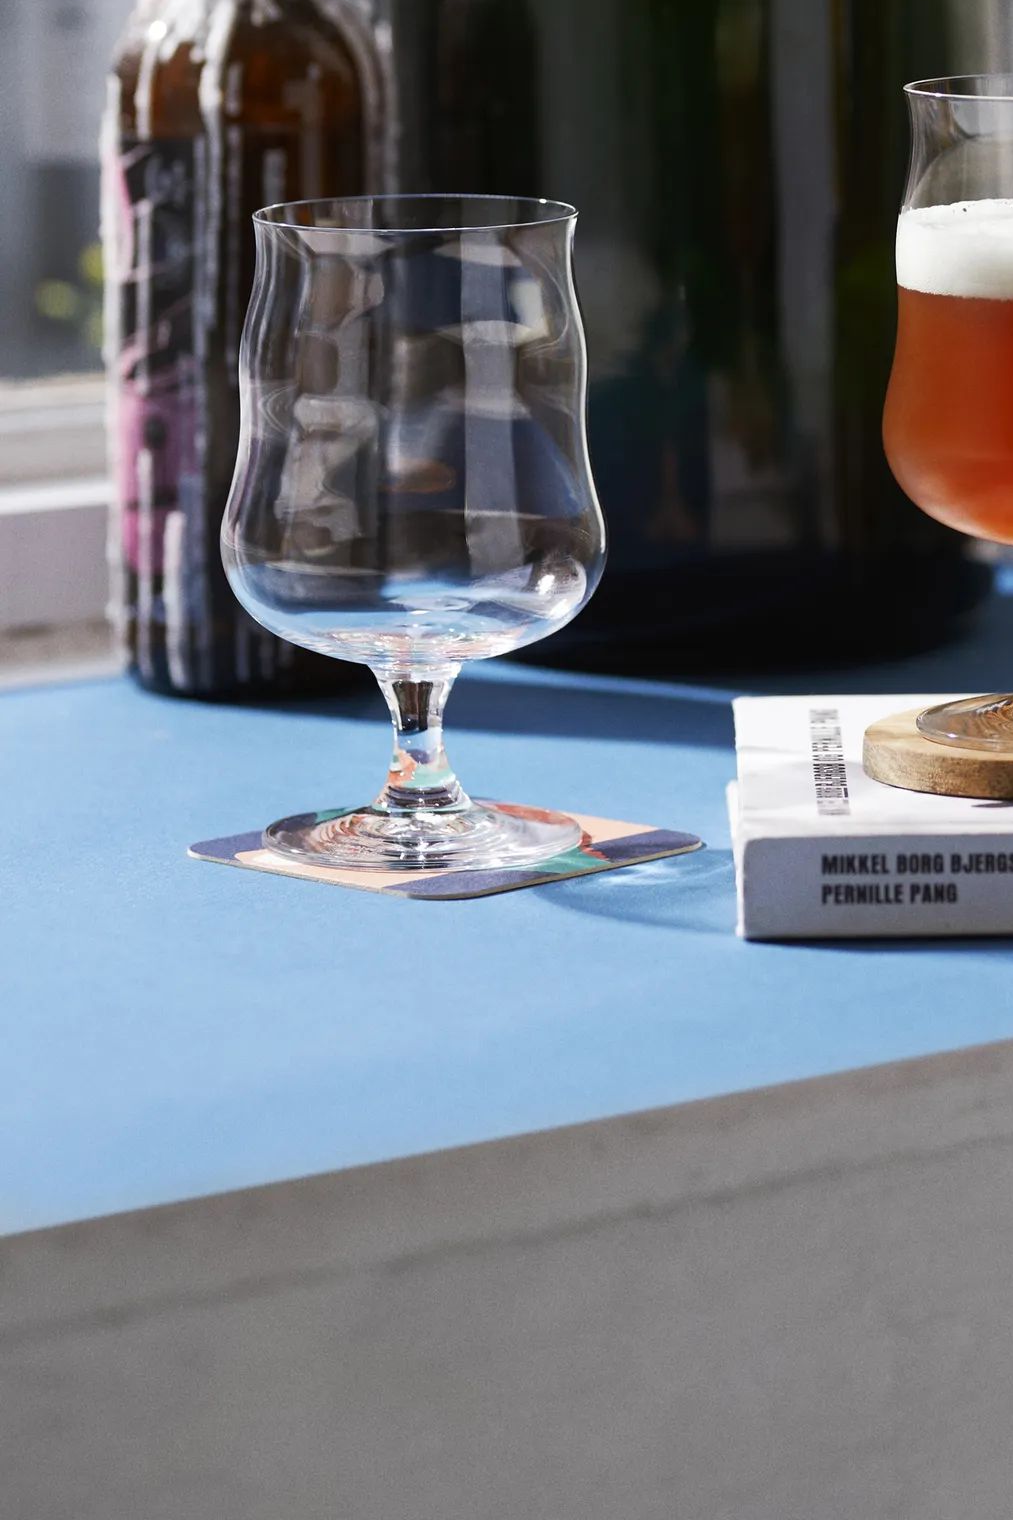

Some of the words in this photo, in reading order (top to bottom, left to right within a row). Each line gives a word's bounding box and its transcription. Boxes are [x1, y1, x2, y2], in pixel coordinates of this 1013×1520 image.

[821, 853, 891, 876] MIKKEL
[896, 853, 945, 875] BORG
[821, 883, 904, 905] PERNILLE
[909, 883, 958, 904] PANG
